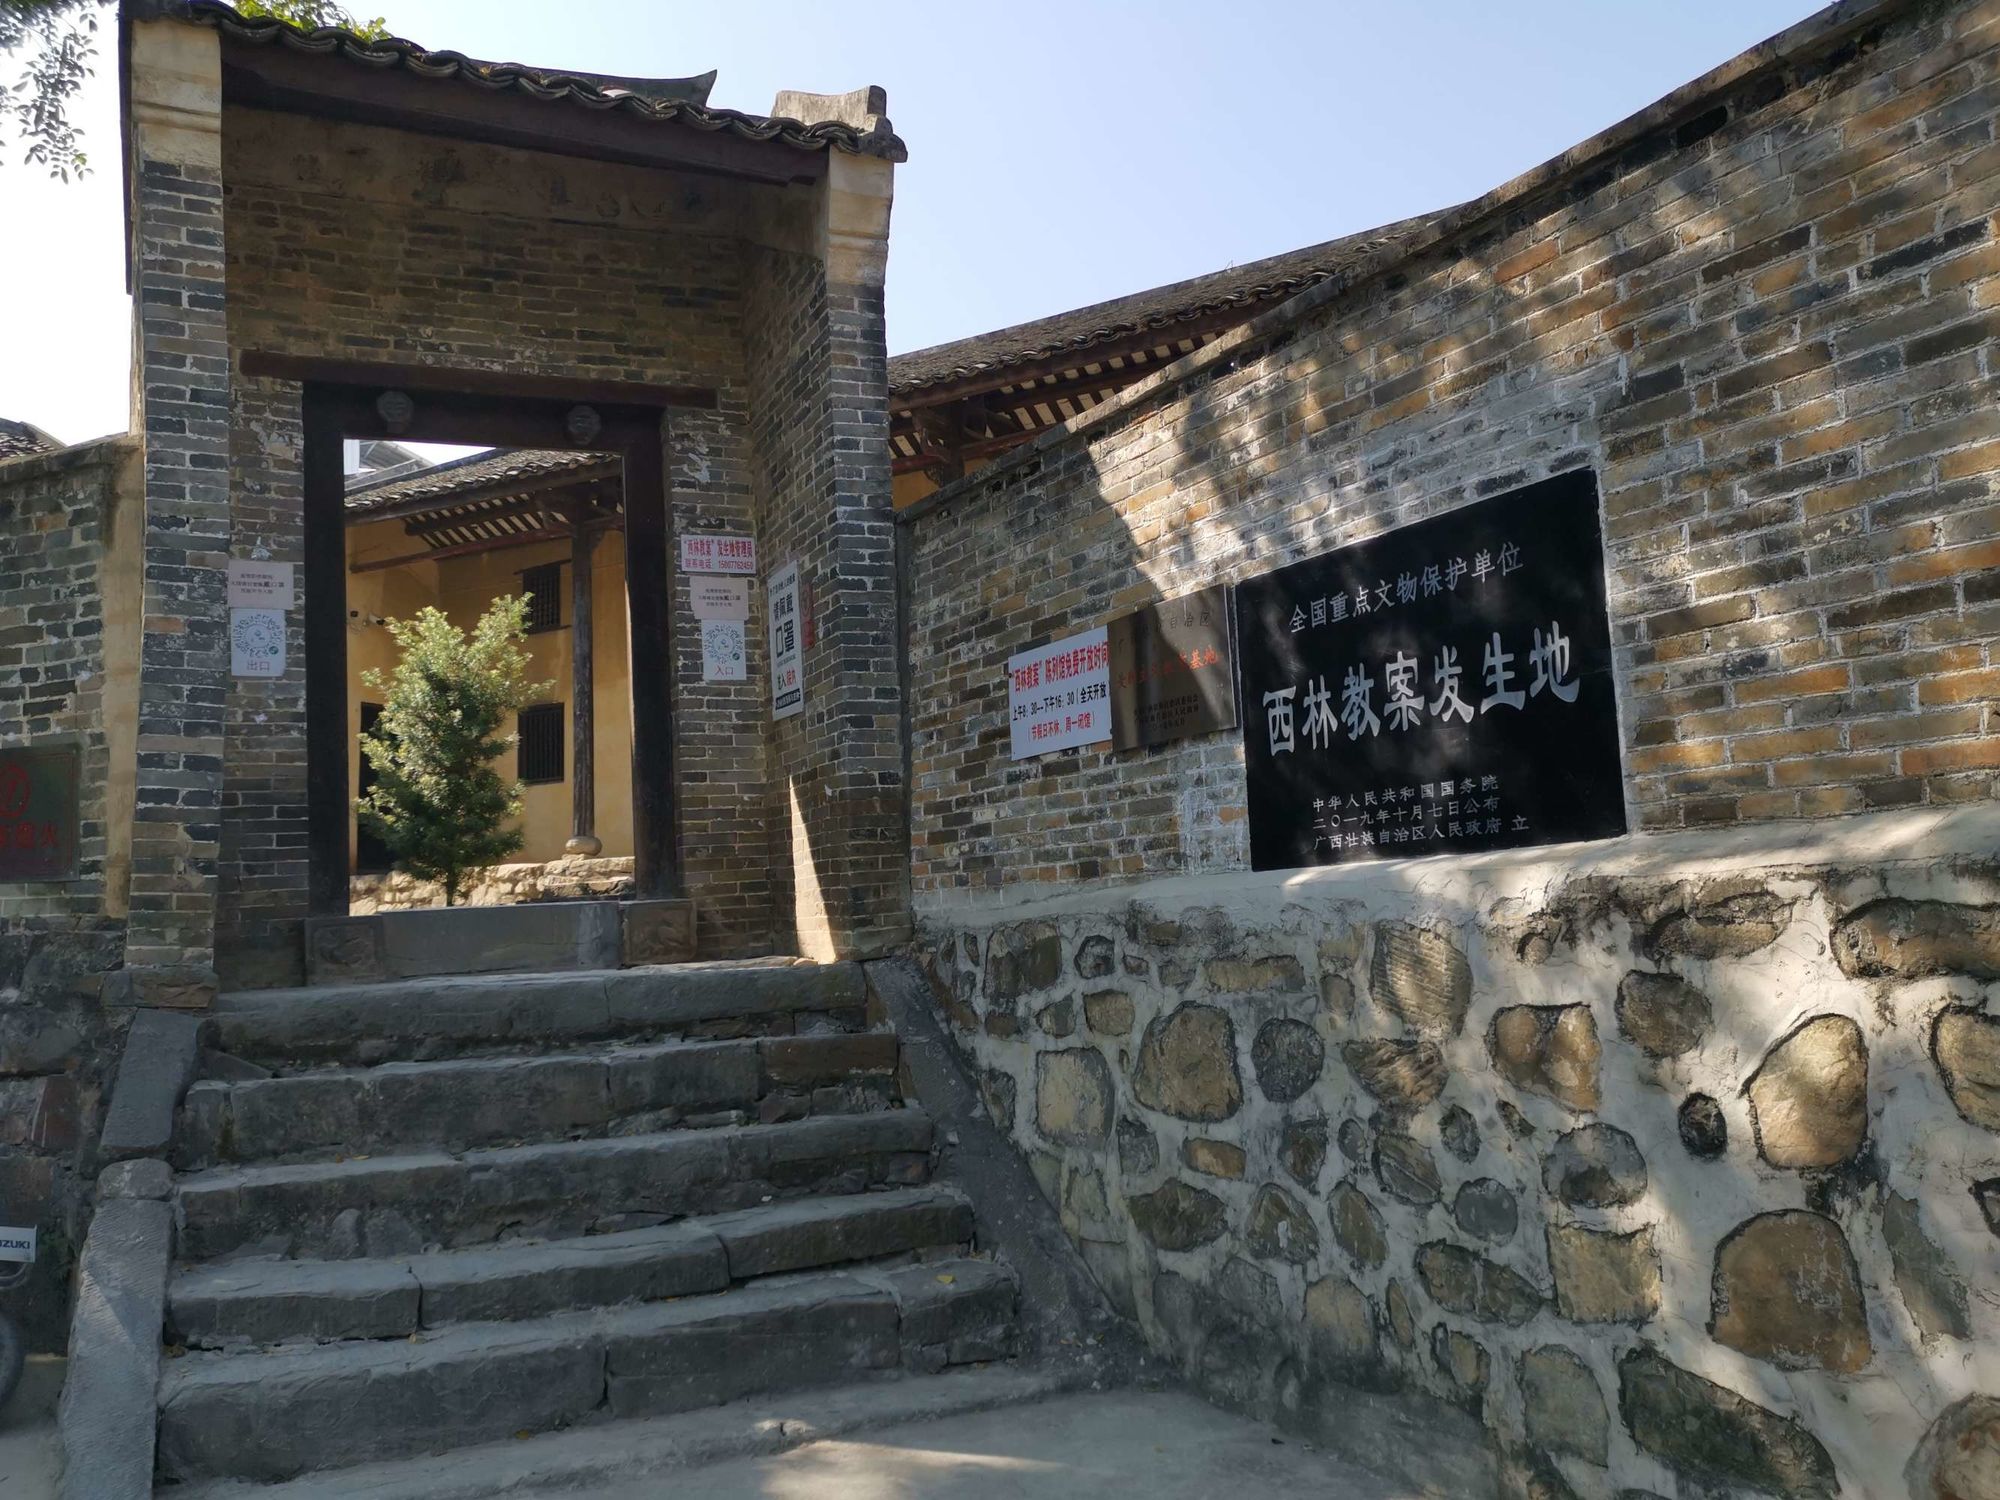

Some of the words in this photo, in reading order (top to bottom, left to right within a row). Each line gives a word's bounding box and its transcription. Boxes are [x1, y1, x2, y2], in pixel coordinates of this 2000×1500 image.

[1289, 541, 1523, 633] 全国重点文物保护单位
[775, 619, 795, 658] 口罩
[246, 659, 270, 671] 出口
[714, 664, 734, 676] 入口
[1262, 620, 1581, 757] 西林教案发生地
[1313, 774, 1499, 813] 中华人民共和国国务院
[1313, 816, 1502, 850] 广西壮族自治区人民政府
[1511, 814, 1529, 831] 立
